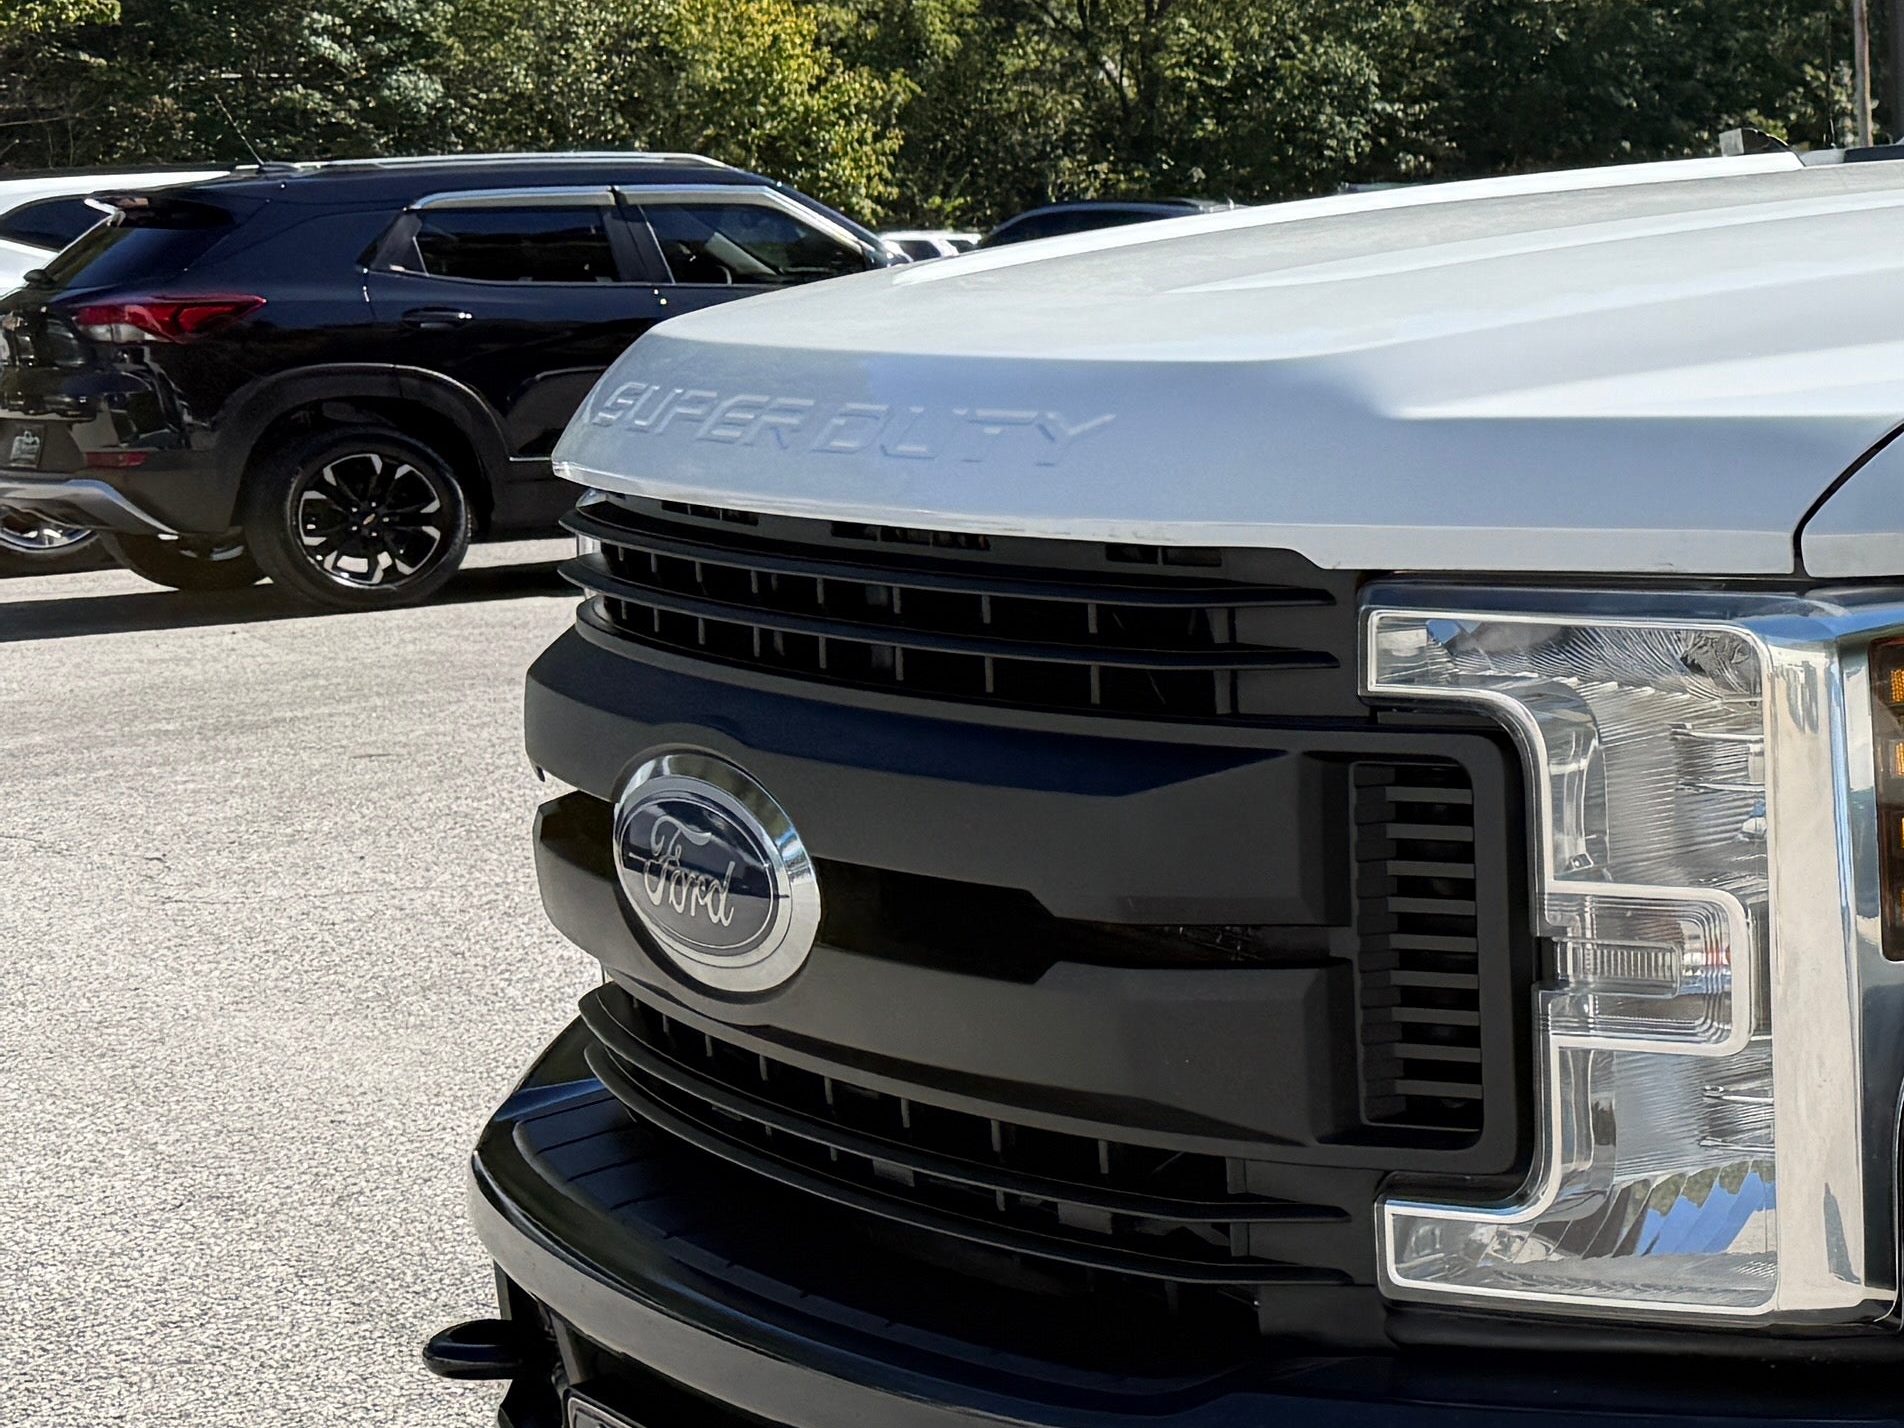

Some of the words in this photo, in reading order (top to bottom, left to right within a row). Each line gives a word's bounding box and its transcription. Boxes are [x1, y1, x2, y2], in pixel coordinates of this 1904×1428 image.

[593, 381, 814, 449] SUPER
[812, 403, 1118, 466] DUTY
[628, 814, 735, 927] Ford
